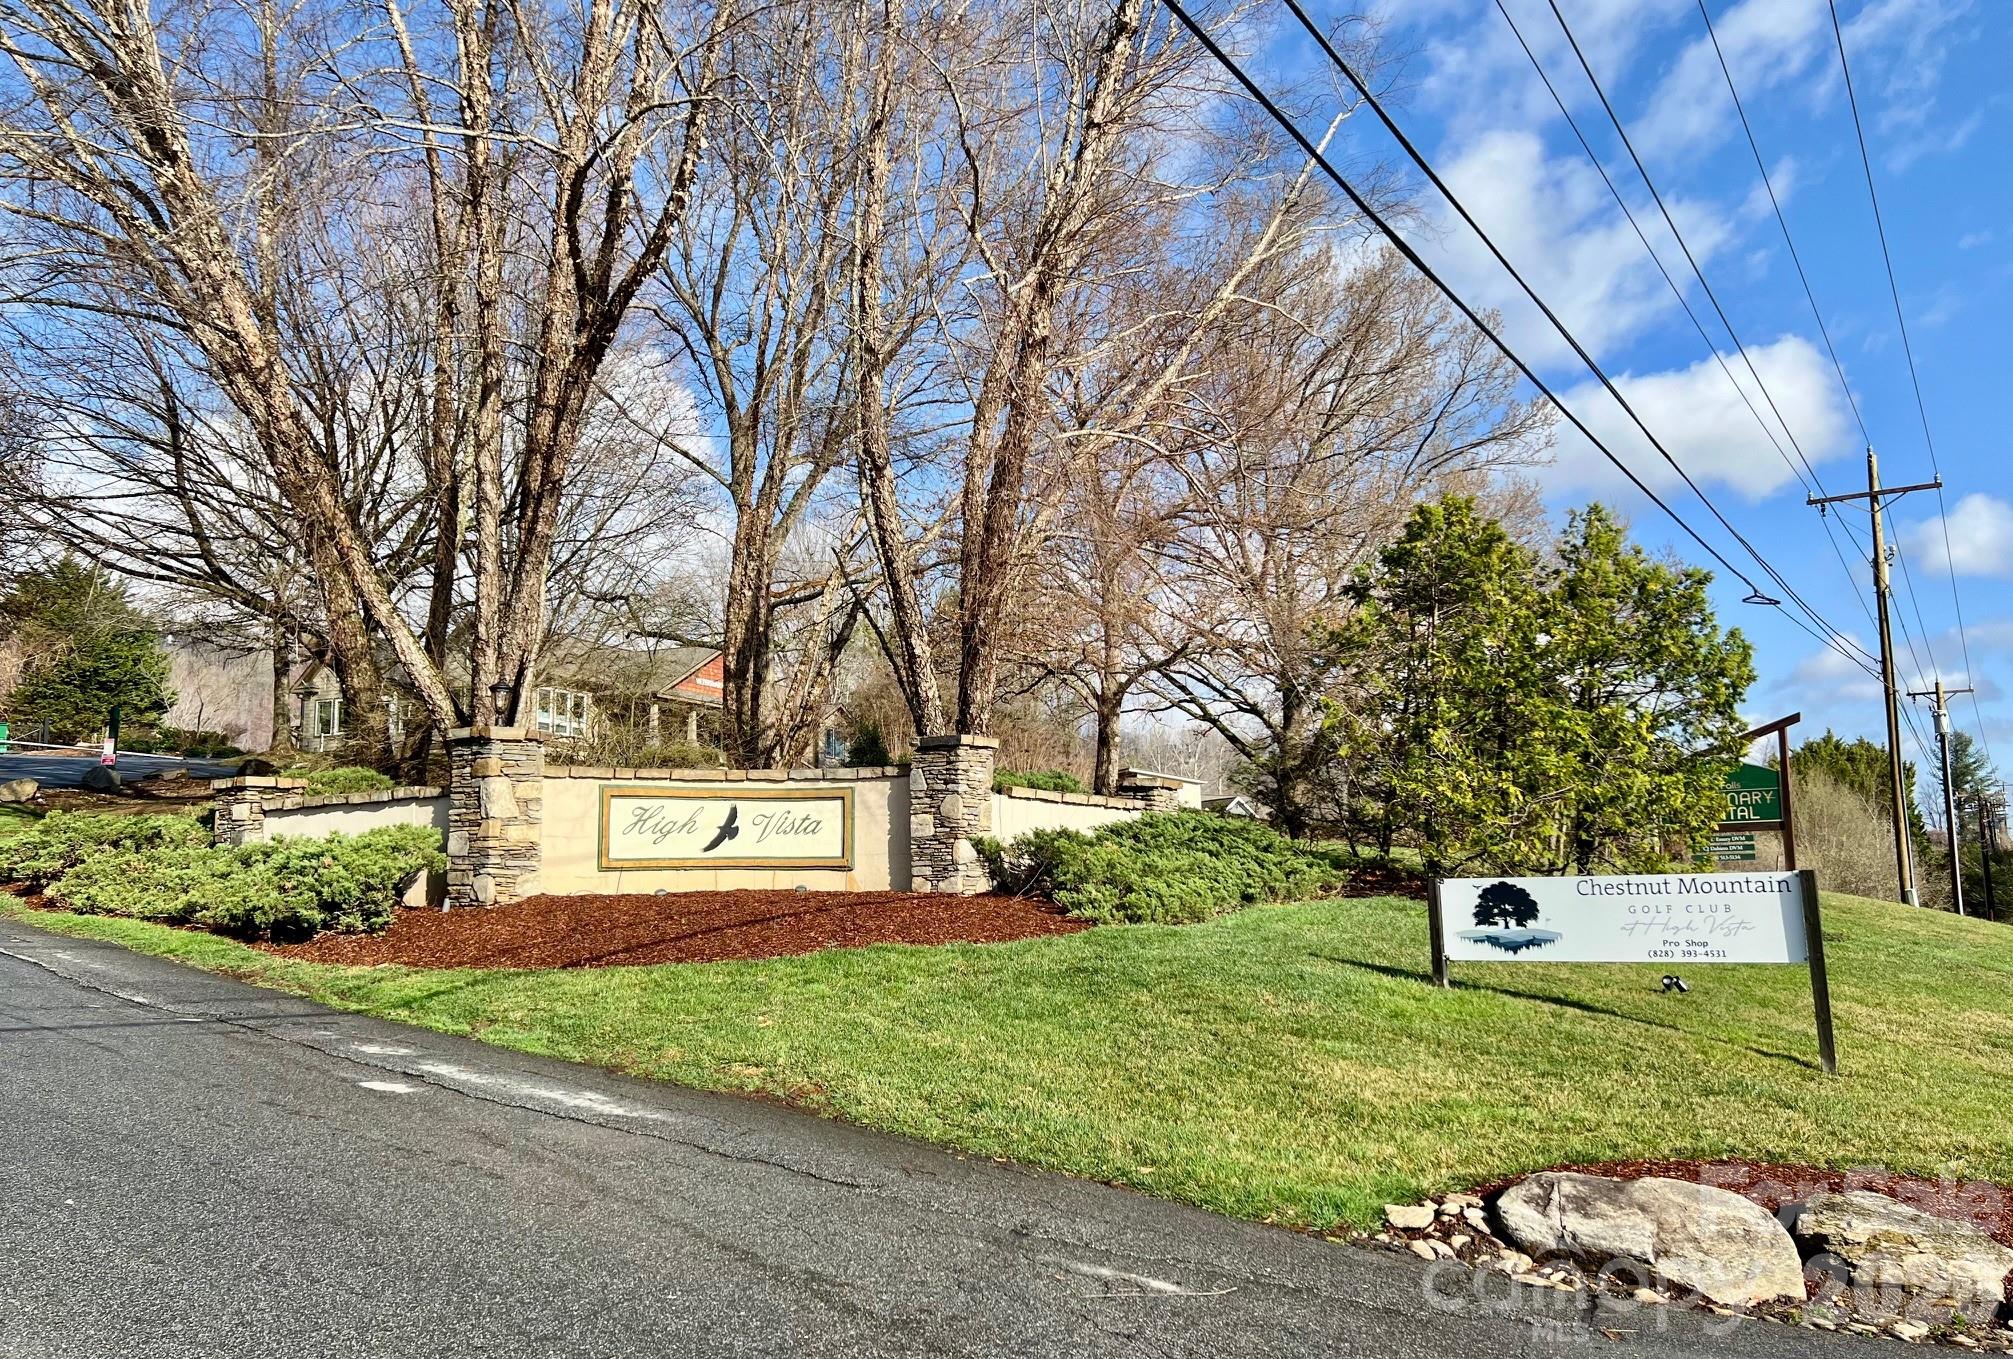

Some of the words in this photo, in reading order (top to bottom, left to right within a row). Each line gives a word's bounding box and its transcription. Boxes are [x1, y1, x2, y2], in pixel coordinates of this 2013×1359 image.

[622, 805, 705, 845] High
[752, 810, 823, 844] Vista
[1576, 878, 1672, 896] Chestnut
[1677, 876, 1792, 895] Mountain
[1628, 904, 1673, 914] GOLF
[1685, 904, 1732, 914] CLUB
[1662, 939, 1680, 947] Pro
[1685, 939, 1709, 948] Shop
[1647, 949, 1675, 959] (828)
[1680, 949, 1727, 958] 393-4531
